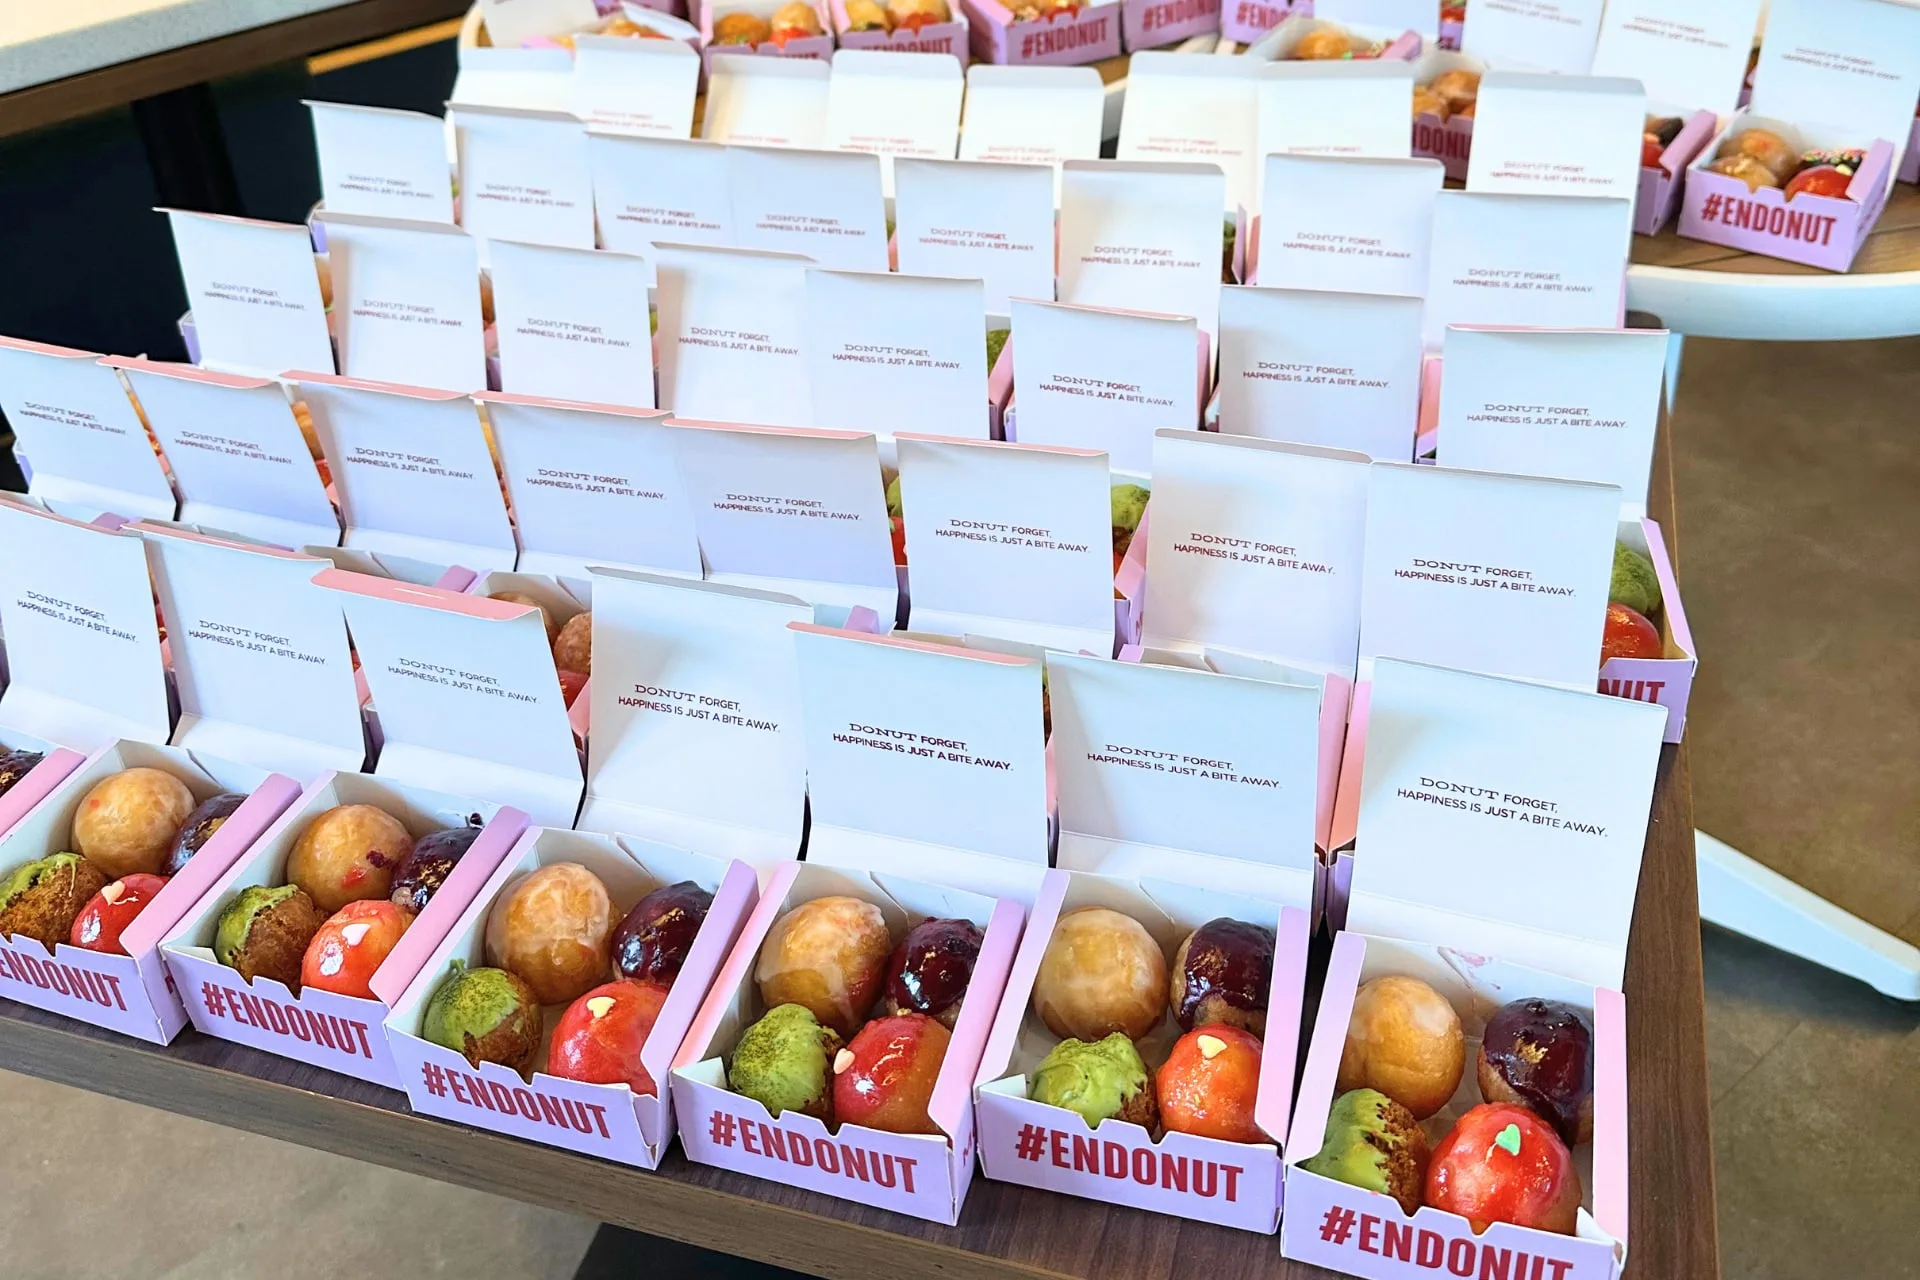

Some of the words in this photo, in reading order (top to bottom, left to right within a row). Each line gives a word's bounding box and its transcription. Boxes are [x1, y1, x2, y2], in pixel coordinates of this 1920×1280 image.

[1021, 17, 1108, 58] #ENDONUT
[1701, 193, 1837, 246] #ENDONUT
[1467, 414, 1520, 423] HAPPINESS
[1484, 404, 1544, 413] DONUT
[714, 502, 763, 512] HAPPINESS
[726, 494, 781, 504] DONUT
[936, 529, 986, 541] HAPPINESS
[1000, 537, 1023, 545] JUST
[1026, 539, 1033, 547] A
[1035, 540, 1055, 549] BITE
[950, 519, 1008, 532] DONUT
[1174, 543, 1227, 558] HAPPINESS
[1230, 552, 1238, 560] IS
[1241, 554, 1266, 564] JUST
[1268, 558, 1275, 566] A
[1277, 559, 1299, 569] BITE
[1301, 563, 1335, 574] AWAY.
[1191, 533, 1251, 548] DONUT
[1255, 543, 1296, 556] FORGET,
[1395, 569, 1454, 583] HAPPINESS
[1457, 577, 1467, 585] IS
[1470, 579, 1498, 588] JUST
[1511, 583, 1535, 592] BITE
[1538, 586, 1576, 597] AWAY.
[1413, 559, 1481, 573] DONUT
[1486, 568, 1532, 580] FORGET,
[199, 620, 251, 637] DONUT
[189, 629, 234, 646] HAPPINESS
[236, 640, 244, 648] IS
[247, 643, 267, 653] JUST
[270, 647, 276, 655] A
[278, 649, 296, 659] BITE
[388, 666, 438, 683] HAPPINESS
[440, 677, 449, 685] IS
[451, 680, 473, 690] JUST
[477, 685, 484, 693] A
[485, 687, 505, 697] BITE
[399, 658, 456, 676] DONUT
[635, 684, 695, 702] DONUT
[699, 696, 740, 712] FORGET,
[619, 696, 672, 713] HAPPINESS
[675, 706, 683, 715] IS
[686, 709, 710, 720] JUST
[713, 713, 720, 722] A
[722, 714, 744, 726] BITE
[746, 719, 780, 732] AWAY.
[849, 723, 916, 741] DONUT
[921, 736, 967, 751] FORGET,
[834, 733, 892, 751] HAPPINESS
[895, 744, 904, 753] IS
[908, 747, 934, 758] JUST
[938, 751, 946, 760] A
[949, 753, 972, 764] BITE
[975, 758, 1013, 771] AWAY.
[1105, 744, 1178, 761] DONUT
[1183, 756, 1233, 770] FORGET,
[1088, 753, 1151, 769] HAPPINESS
[1155, 763, 1164, 771] IS
[1168, 766, 1197, 776] JUST
[1201, 770, 1209, 778] A
[1212, 772, 1237, 782] BITE
[1241, 776, 1282, 788] AWAY.
[1420, 777, 1499, 800] DONUT
[1504, 794, 1557, 813] FORGET,
[1397, 788, 1467, 810] HAPPINESS
[1470, 803, 1482, 813] IS
[1485, 806, 1517, 819] JUST
[1520, 812, 1529, 822] A
[1532, 815, 1561, 828] BITE
[1563, 821, 1608, 837] AWAY.
[202, 981, 373, 1059] #ENDONUT
[421, 1061, 611, 1139] #ENDONUT
[709, 1110, 917, 1193] #ENDONUT
[1015, 1123, 1244, 1202] #ENDONUT
